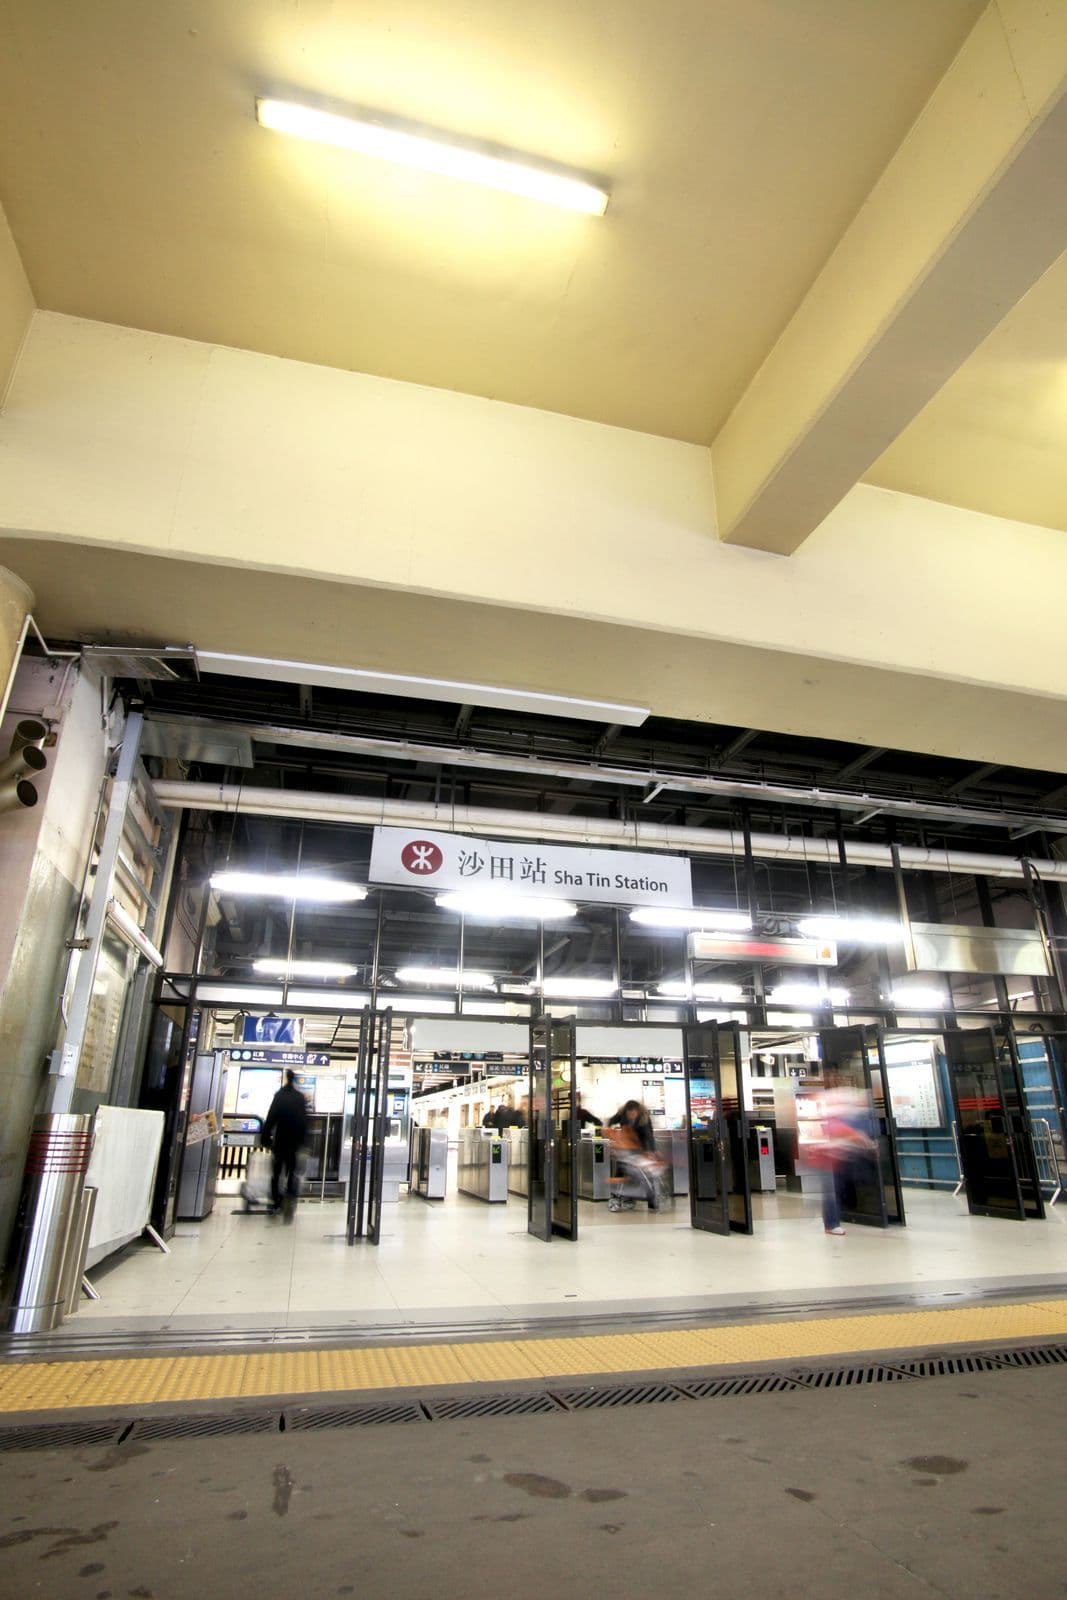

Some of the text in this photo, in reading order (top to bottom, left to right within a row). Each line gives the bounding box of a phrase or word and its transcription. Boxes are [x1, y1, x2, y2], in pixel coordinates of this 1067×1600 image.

[458, 849, 668, 892] 沙田站 Sha Tin Station
